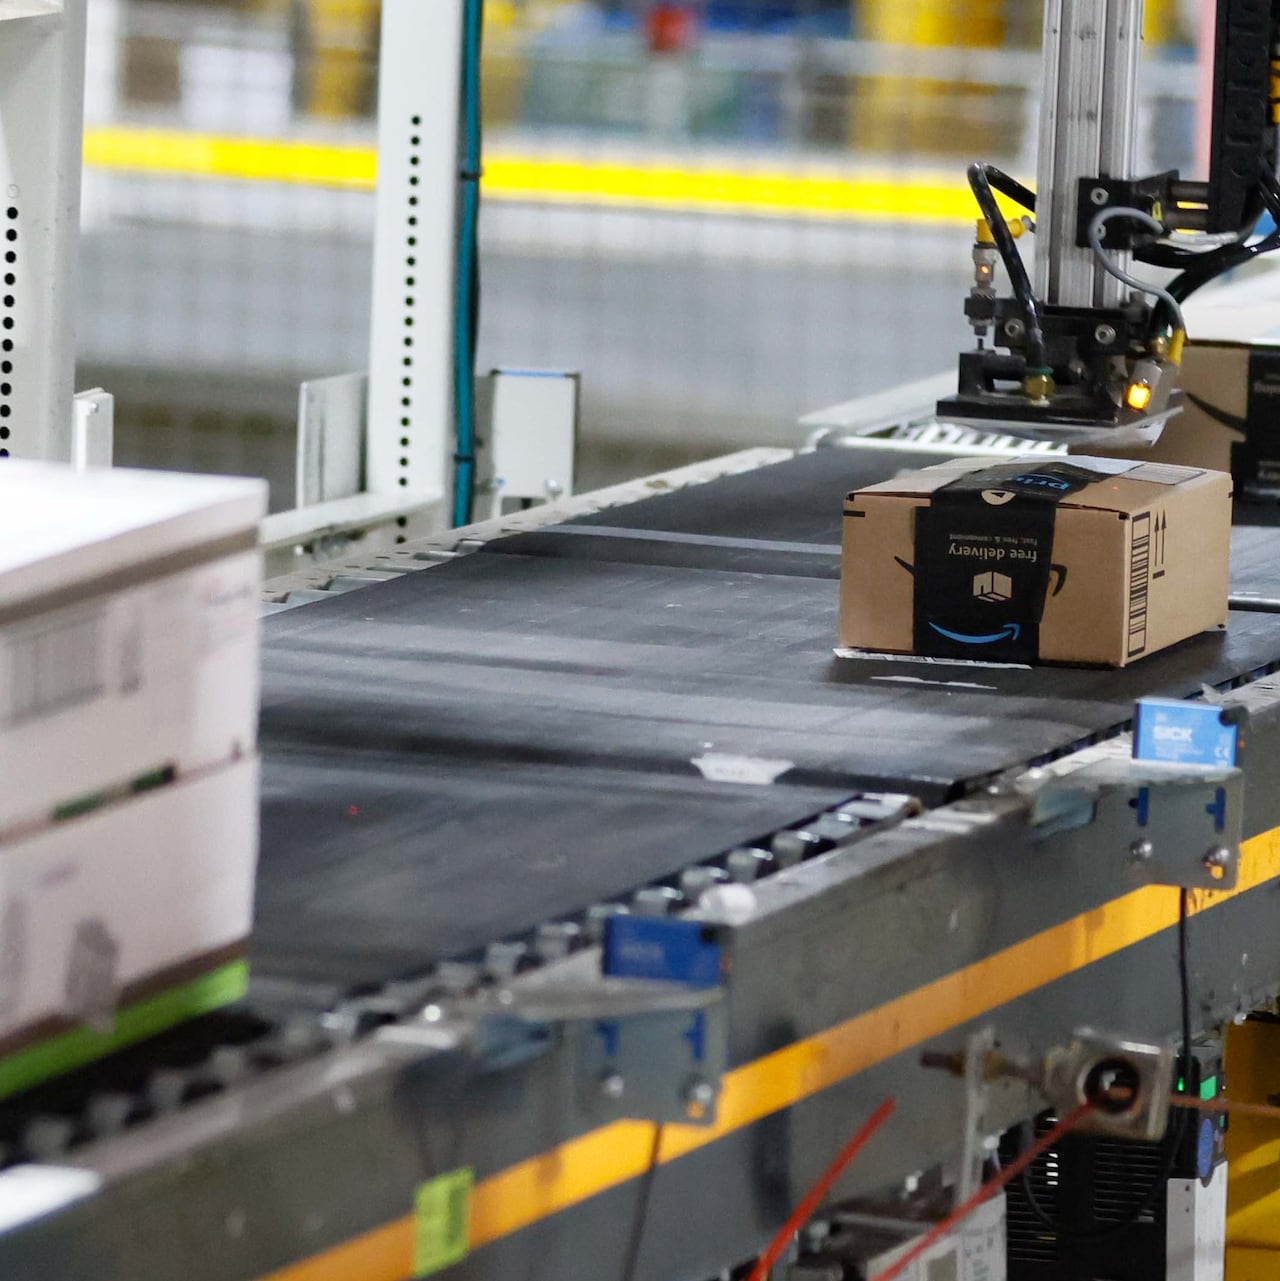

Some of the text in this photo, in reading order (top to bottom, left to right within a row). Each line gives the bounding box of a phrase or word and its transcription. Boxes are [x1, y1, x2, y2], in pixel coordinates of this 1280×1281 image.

[948, 542, 1038, 563] free delivery
[1153, 725, 1193, 742] SICK
